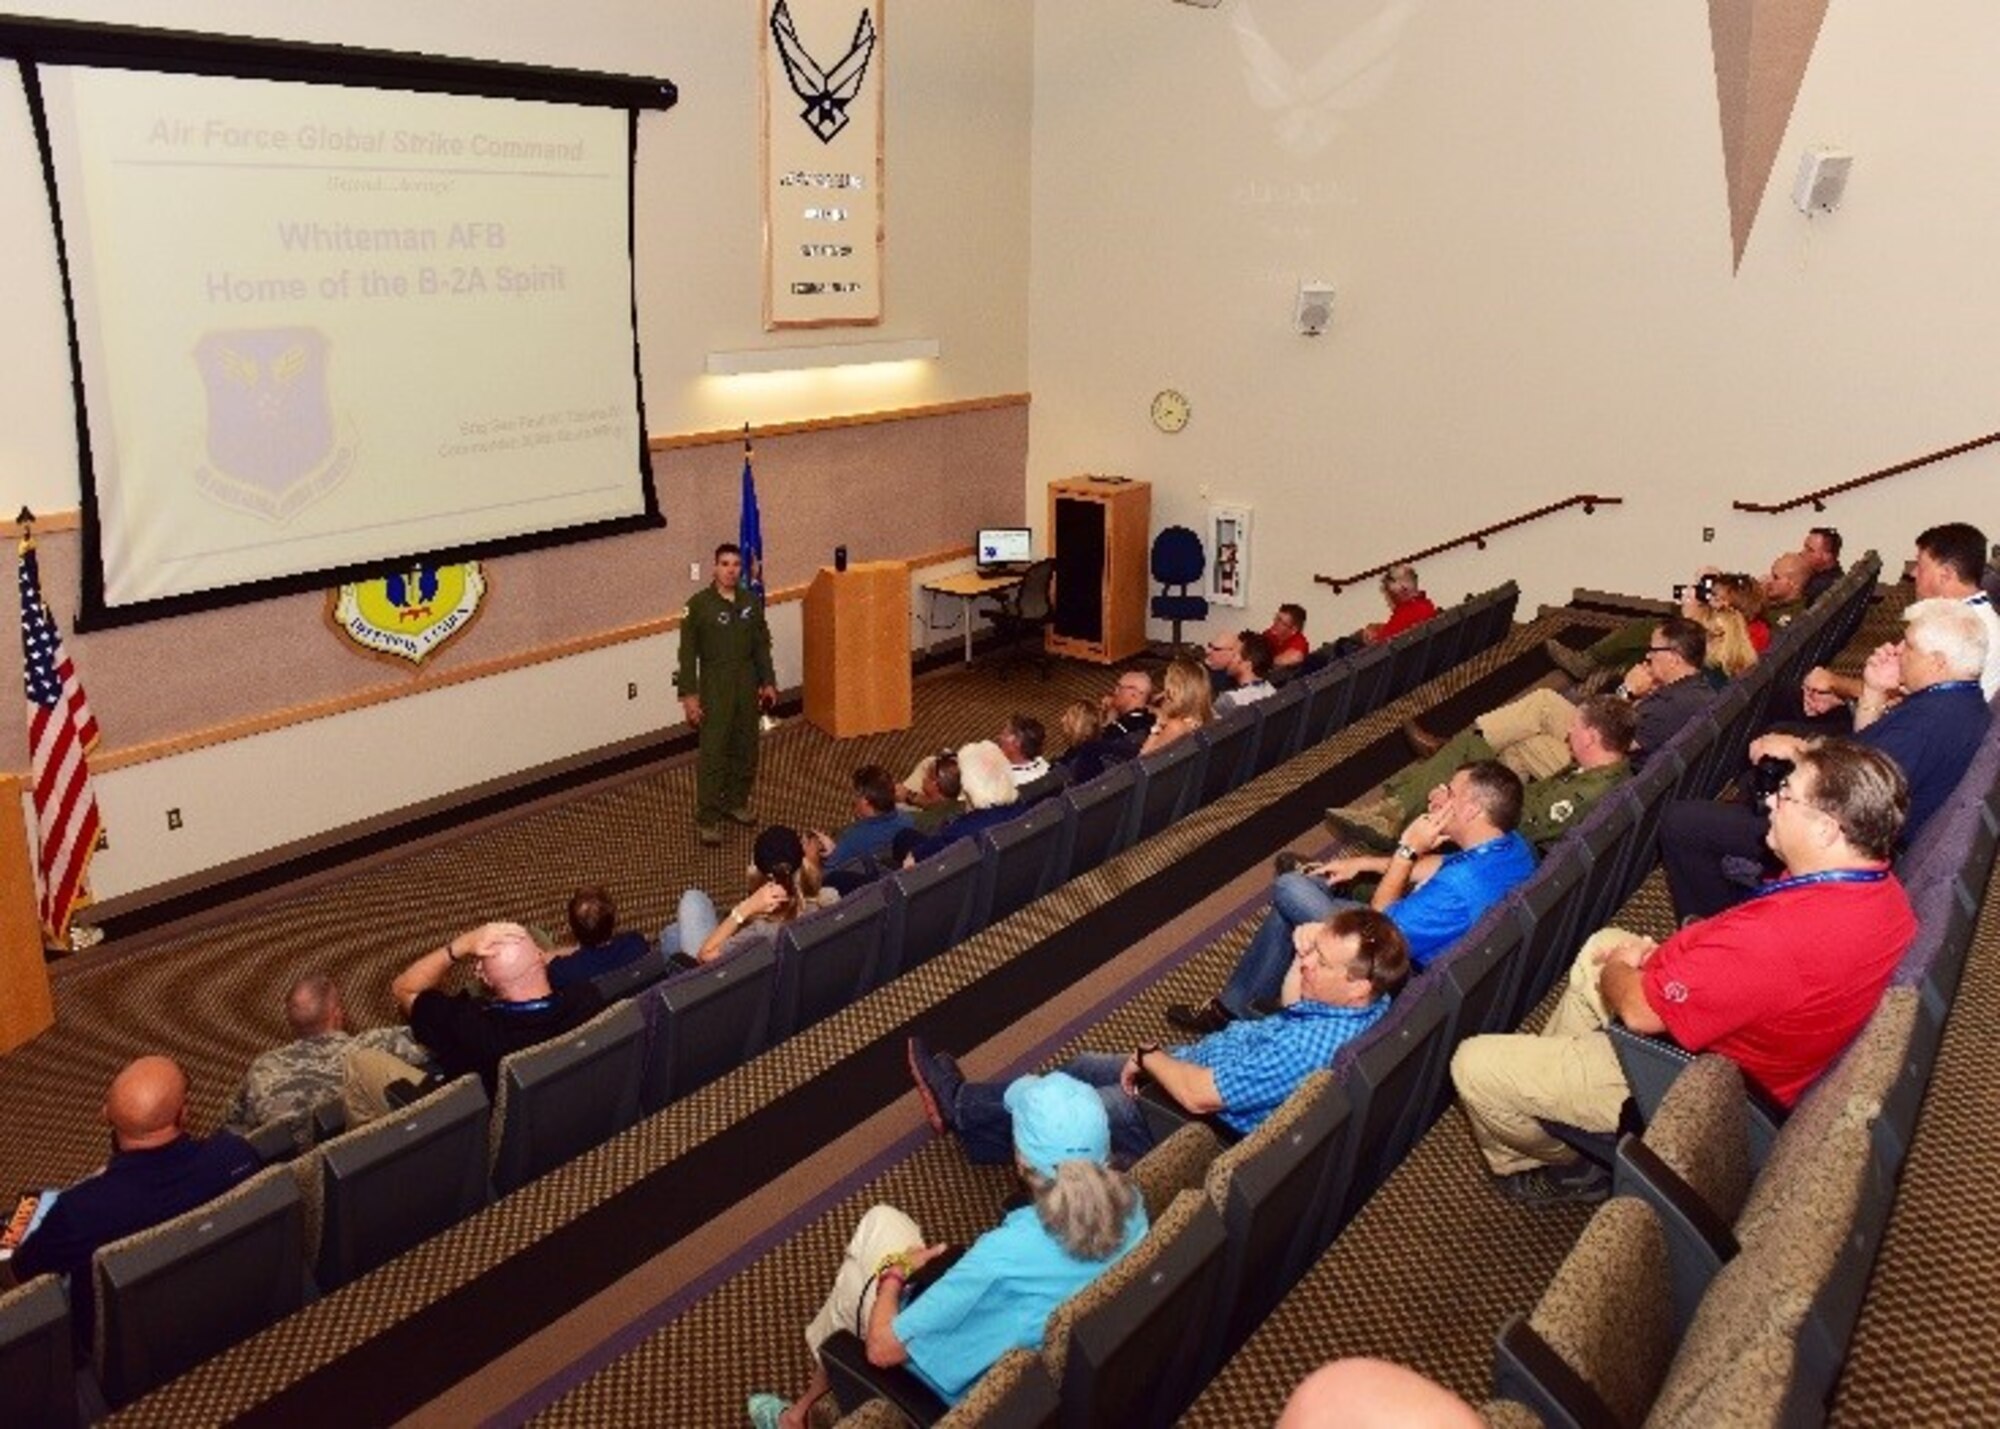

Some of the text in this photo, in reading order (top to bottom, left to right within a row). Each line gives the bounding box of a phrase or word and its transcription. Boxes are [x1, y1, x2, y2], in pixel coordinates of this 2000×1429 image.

[148, 118, 584, 162] Air Force Global Strike Command
[277, 222, 506, 252] Whiteman AFB
[206, 263, 566, 303] Home of the B-2A Spirit
